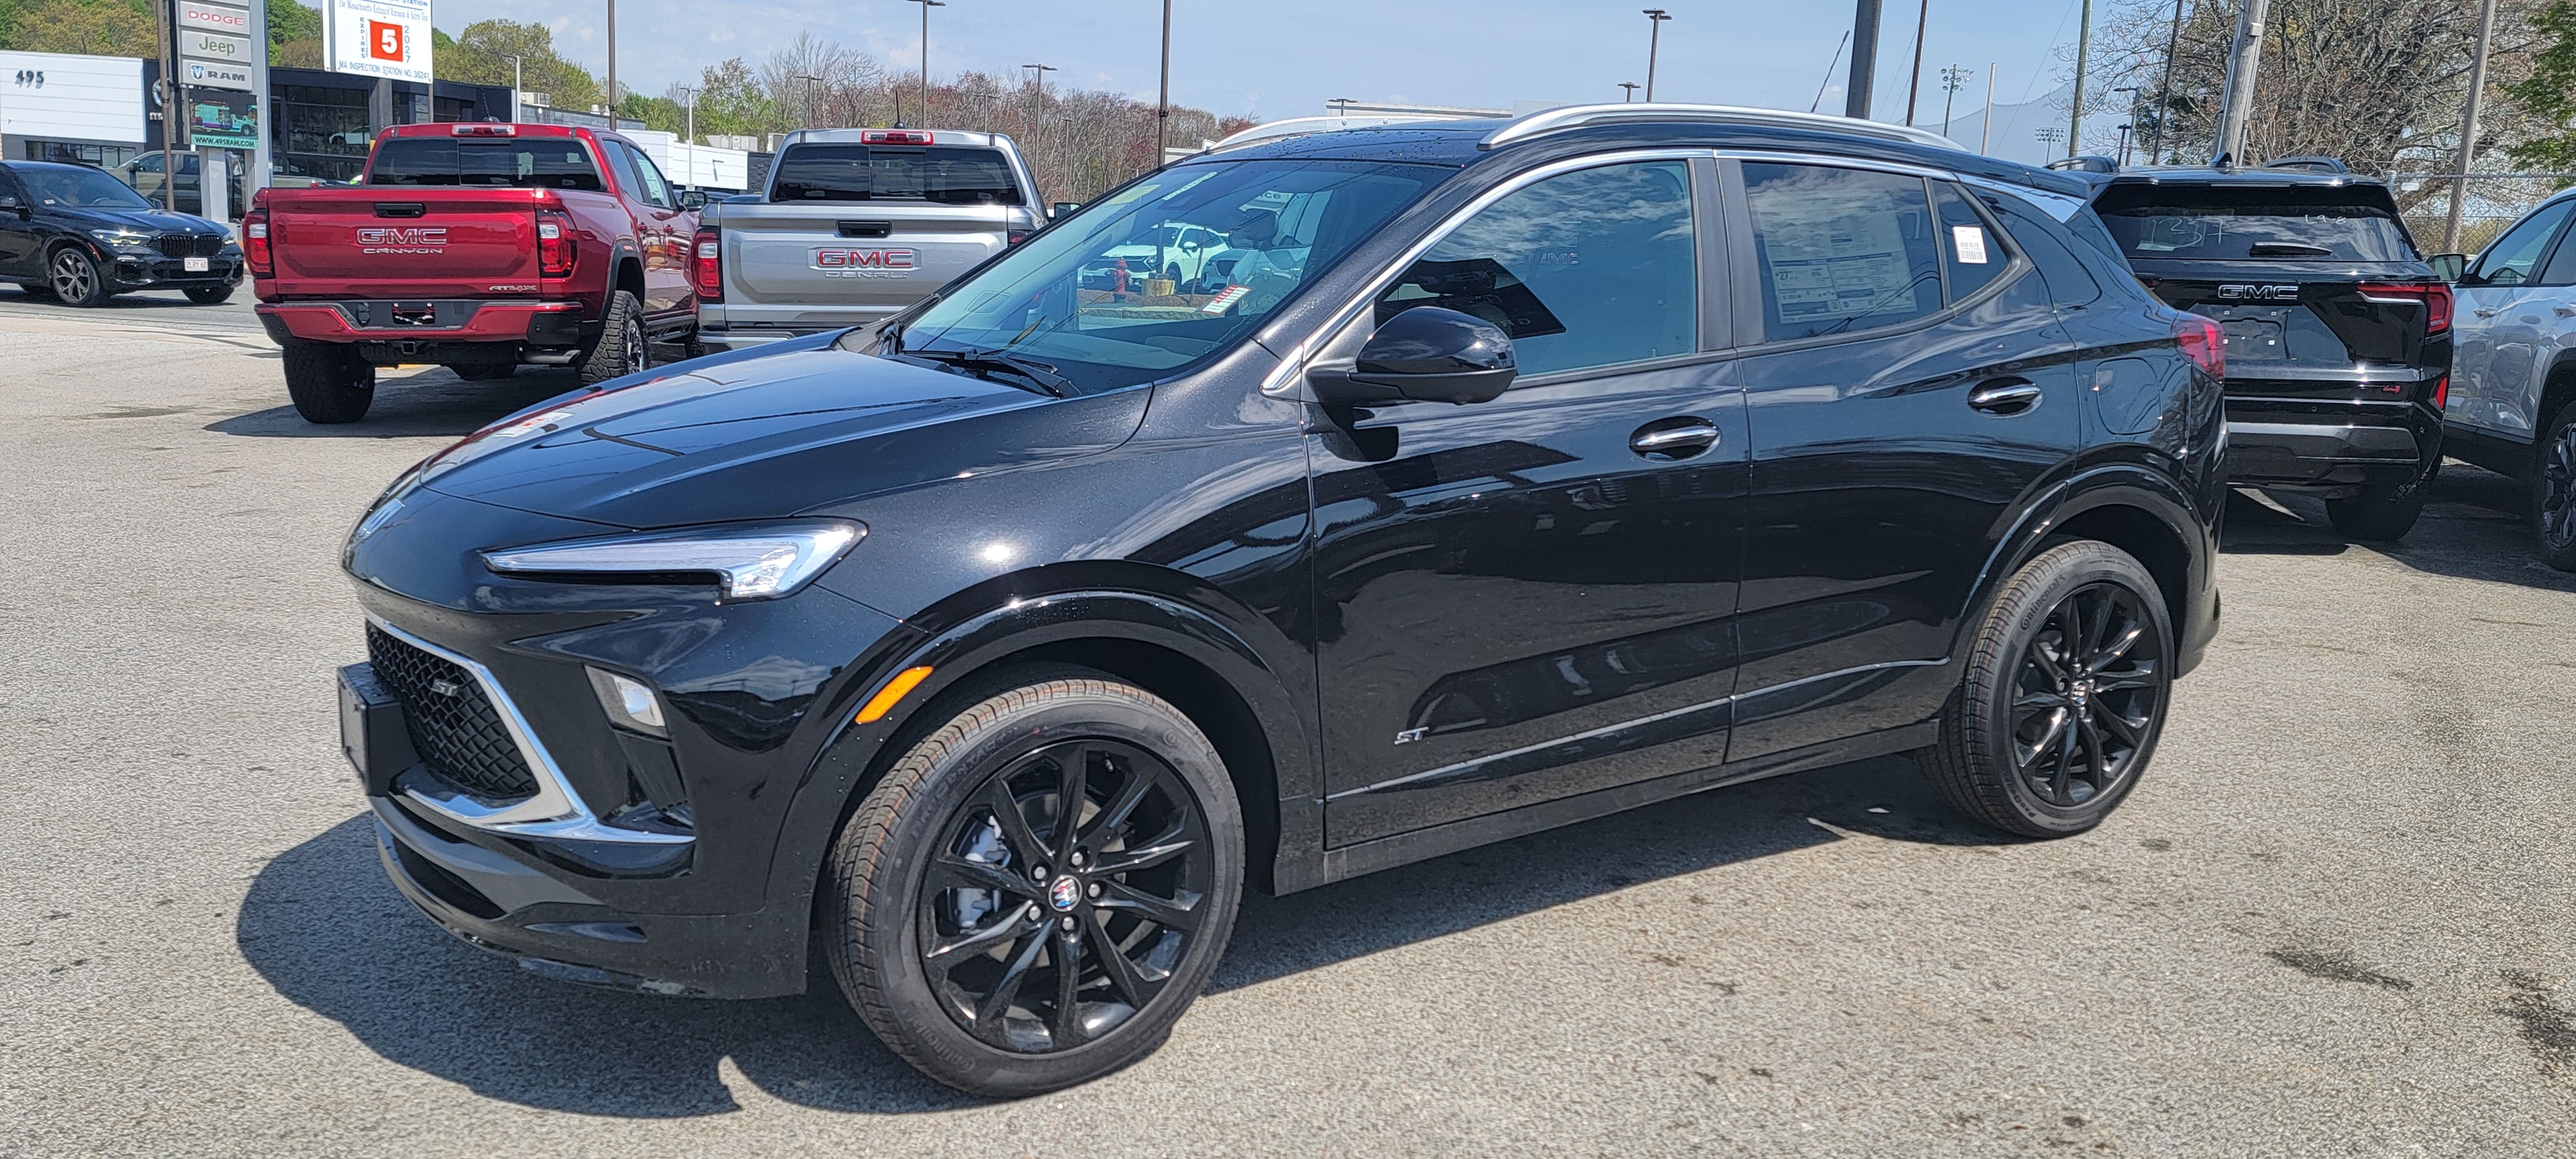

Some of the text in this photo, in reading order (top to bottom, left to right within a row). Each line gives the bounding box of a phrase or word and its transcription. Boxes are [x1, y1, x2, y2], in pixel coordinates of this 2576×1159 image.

[189, 11, 244, 25] DODGE
[199, 37, 235, 56] Jeep
[381, 29, 397, 54] 5
[207, 70, 245, 82] RAM
[339, 61, 348, 69] MA
[350, 62, 380, 73] INSPECTION
[383, 66, 402, 76] STATION
[15, 70, 44, 84] 495
[357, 229, 448, 245] GMC
[818, 250, 914, 267] GMC
[825, 271, 908, 279] DENALI
[2218, 284, 2298, 301] GMC
[431, 679, 459, 697] ST
[1394, 726, 1430, 746] ST
